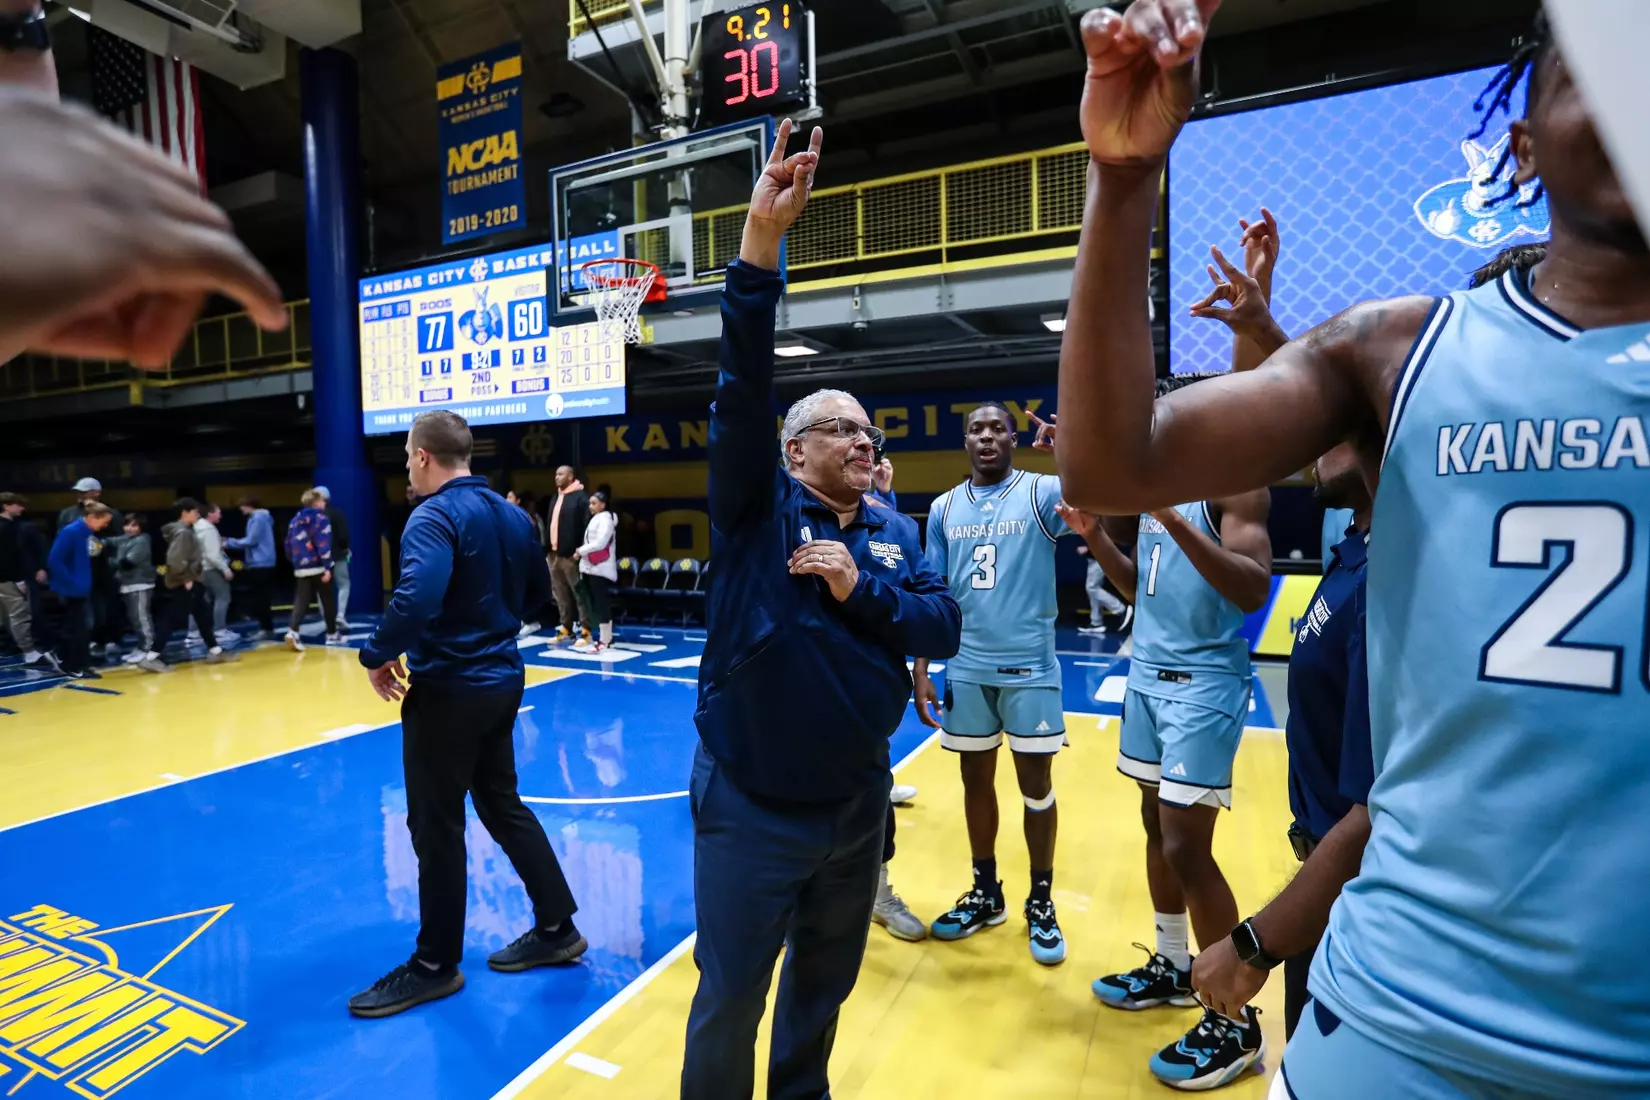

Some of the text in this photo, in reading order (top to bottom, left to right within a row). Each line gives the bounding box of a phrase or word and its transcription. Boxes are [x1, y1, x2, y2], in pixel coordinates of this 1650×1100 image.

[723, 40, 779, 106] 30
[442, 87, 519, 118] KANSAS CITY
[447, 129, 519, 177] NCAA
[448, 163, 519, 196] TOURNAMENT
[449, 204, 519, 236] 2019-2020
[363, 275, 423, 297] KANSAS
[427, 267, 466, 286] CITY
[420, 298, 452, 311] ROOS
[514, 301, 543, 338] 60
[425, 315, 447, 351] 77
[561, 329, 589, 346] 12 2
[425, 361, 431, 374] 1
[442, 359, 449, 372] 7
[514, 349, 521, 364] 7
[536, 345, 543, 361] 2
[561, 345, 611, 364] 20 0 0
[471, 371, 491, 384] 2ND
[515, 378, 544, 394] BONUS
[561, 368, 572, 384] 25
[585, 367, 590, 381] 0
[605, 364, 611, 379] 0
[471, 385, 492, 396] POSS
[374, 414, 397, 426] THANK
[400, 413, 413, 423] YOU
[485, 402, 527, 416] PARTNERS
[605, 399, 1044, 453] KAN CITY
[1436, 415, 1650, 477] KANSA
[948, 520, 1027, 541] KANSAS CITY
[971, 543, 998, 590] 3
[1146, 542, 1162, 597] 1
[1477, 500, 1650, 695] 2
[8, 903, 100, 940] THE
[0, 919, 248, 1100] MMIT
